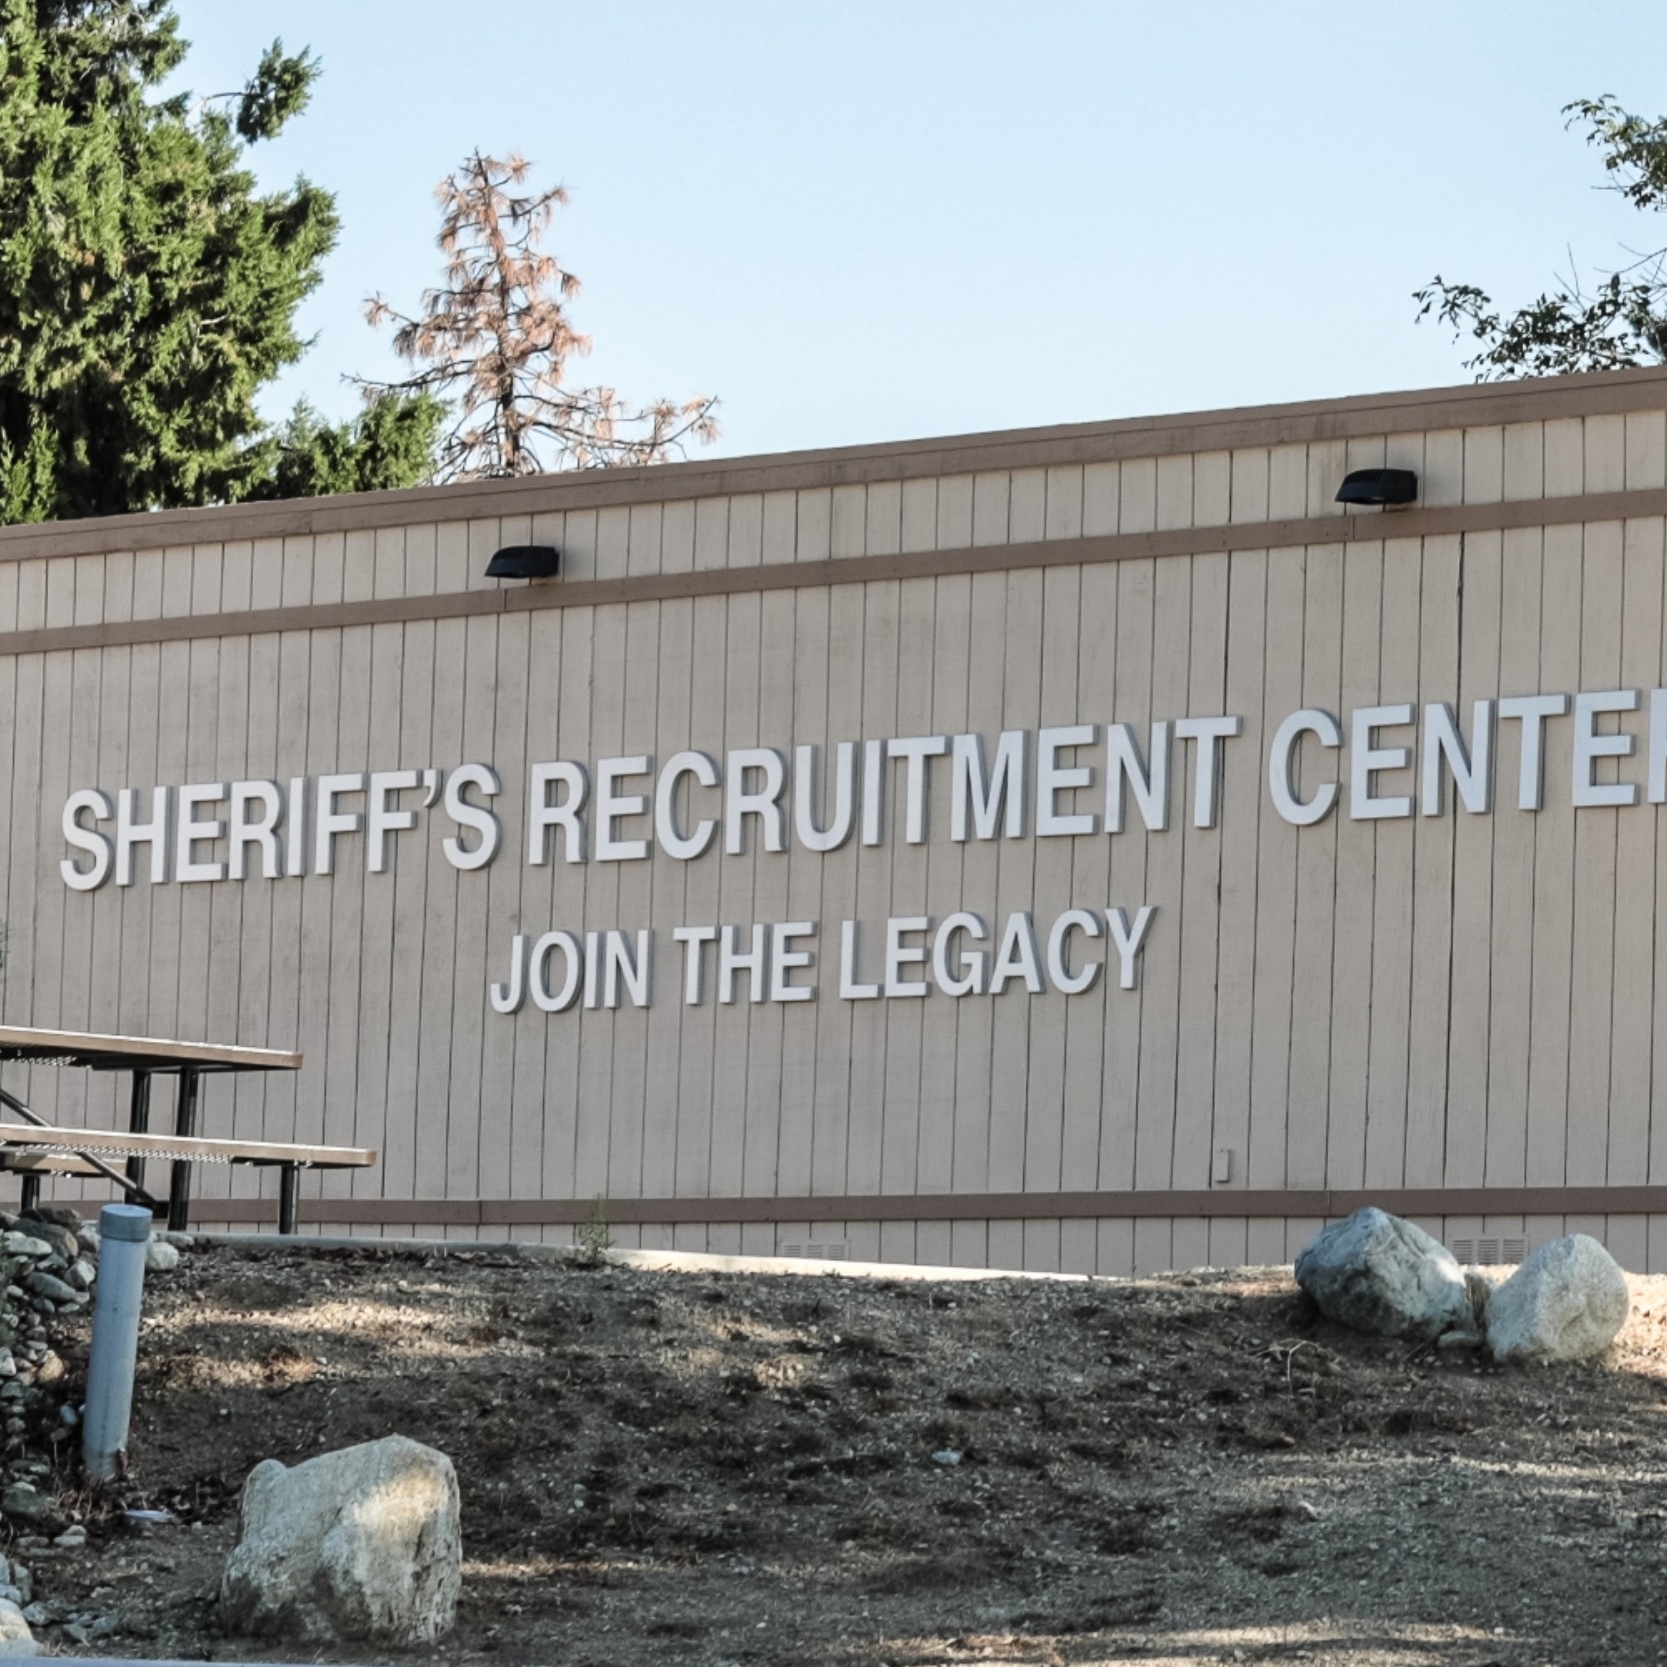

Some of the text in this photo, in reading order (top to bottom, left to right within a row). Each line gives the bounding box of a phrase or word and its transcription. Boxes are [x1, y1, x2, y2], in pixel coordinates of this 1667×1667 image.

[60, 763, 502, 891] SHERIFF'S
[529, 716, 1241, 866] RECRUITMENT
[491, 905, 1158, 1013] JOIN THE LEGACY
